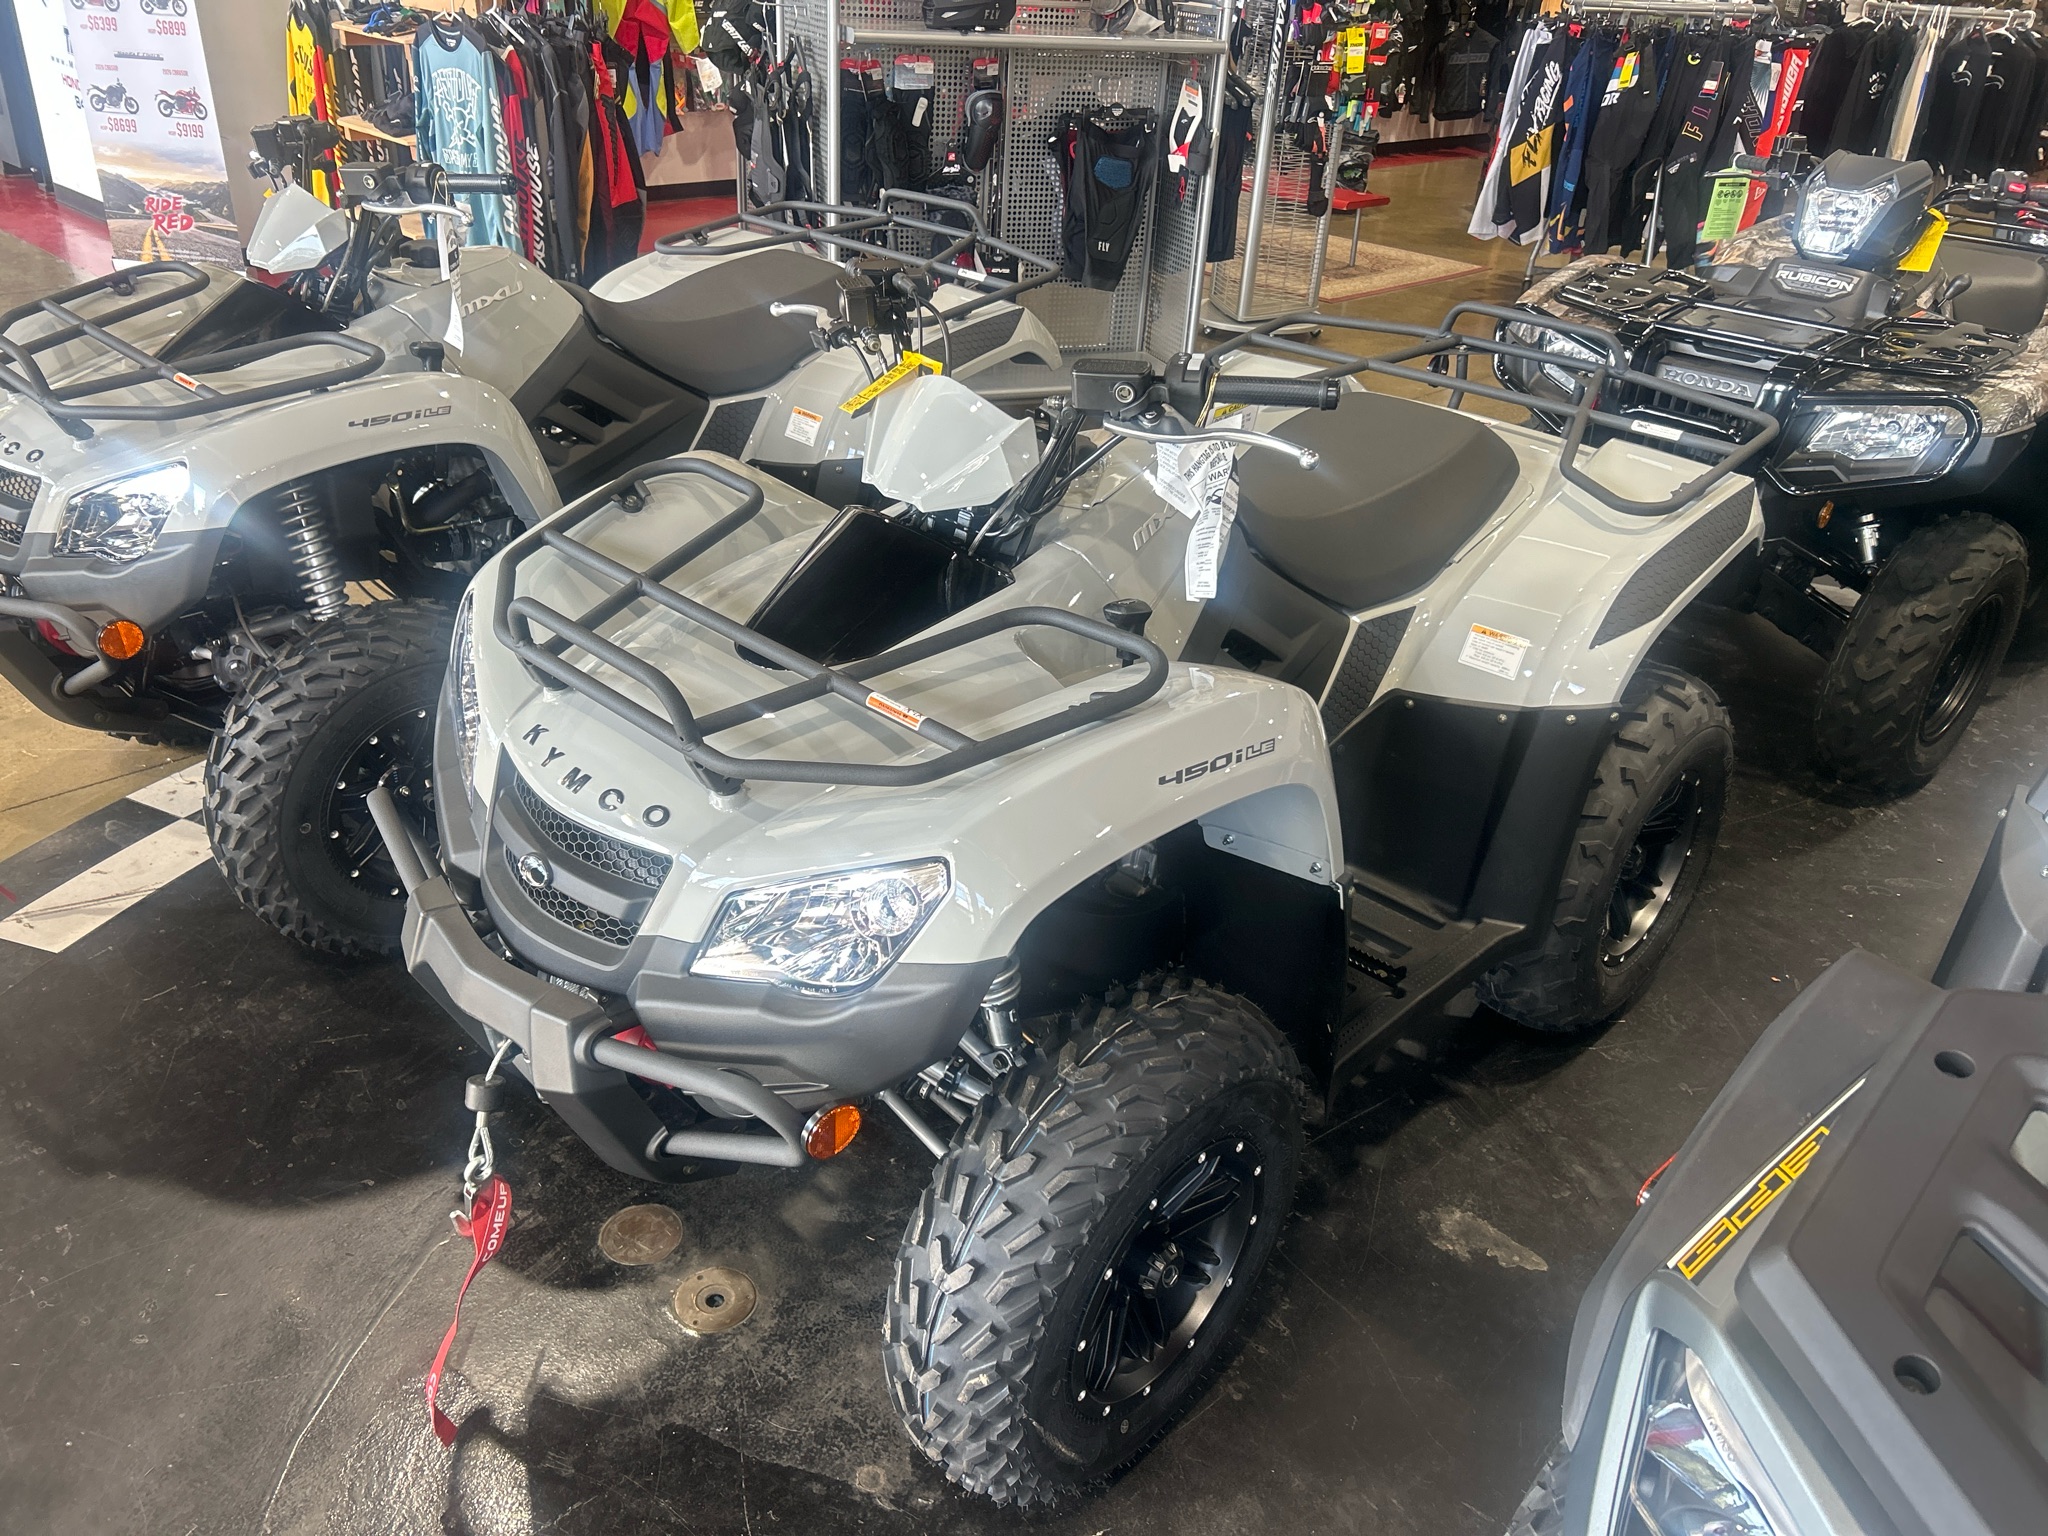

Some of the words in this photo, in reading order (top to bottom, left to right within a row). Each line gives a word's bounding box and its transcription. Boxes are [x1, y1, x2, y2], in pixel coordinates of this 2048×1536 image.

[87, 14, 118, 31] $6399
[984, 9, 1000, 20] FLY
[155, 19, 187, 36] $6899
[1530, 60, 1562, 130] RACING
[107, 116, 138, 133] $8699
[176, 122, 204, 139] $9199
[145, 196, 184, 213] RIDE
[152, 213, 195, 236] RED
[1097, 241, 1110, 252] FLY
[1776, 270, 1854, 293] RUBICON
[1662, 368, 1753, 398] HONDA
[522, 723, 671, 829] KYMCO
[482, 1182, 508, 1263] COMEUP
